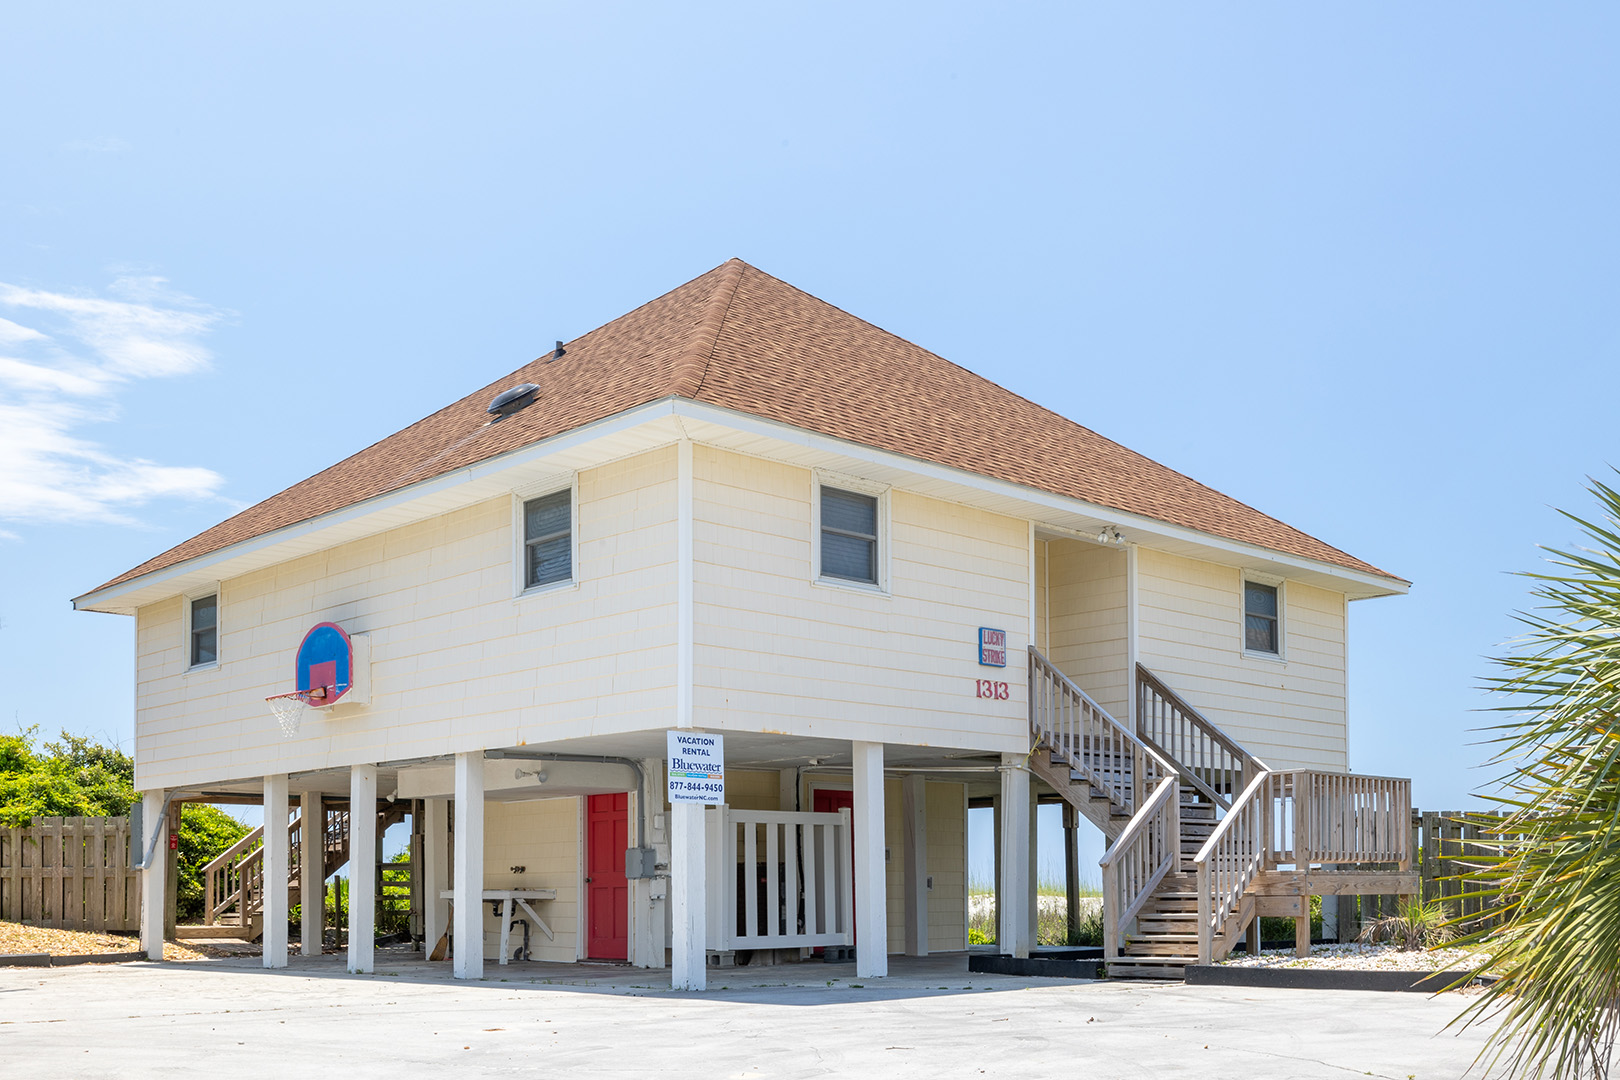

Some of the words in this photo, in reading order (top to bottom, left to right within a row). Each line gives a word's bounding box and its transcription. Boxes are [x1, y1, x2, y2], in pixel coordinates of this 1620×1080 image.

[983, 630, 1004, 647] LUCKY
[982, 648, 1005, 665] STRIKE
[976, 679, 1009, 700] 1313
[677, 736, 715, 746] VACATION
[682, 747, 710, 757] RENTAL
[672, 758, 721, 772] Bluewater
[670, 782, 723, 792] 877-844-9450
